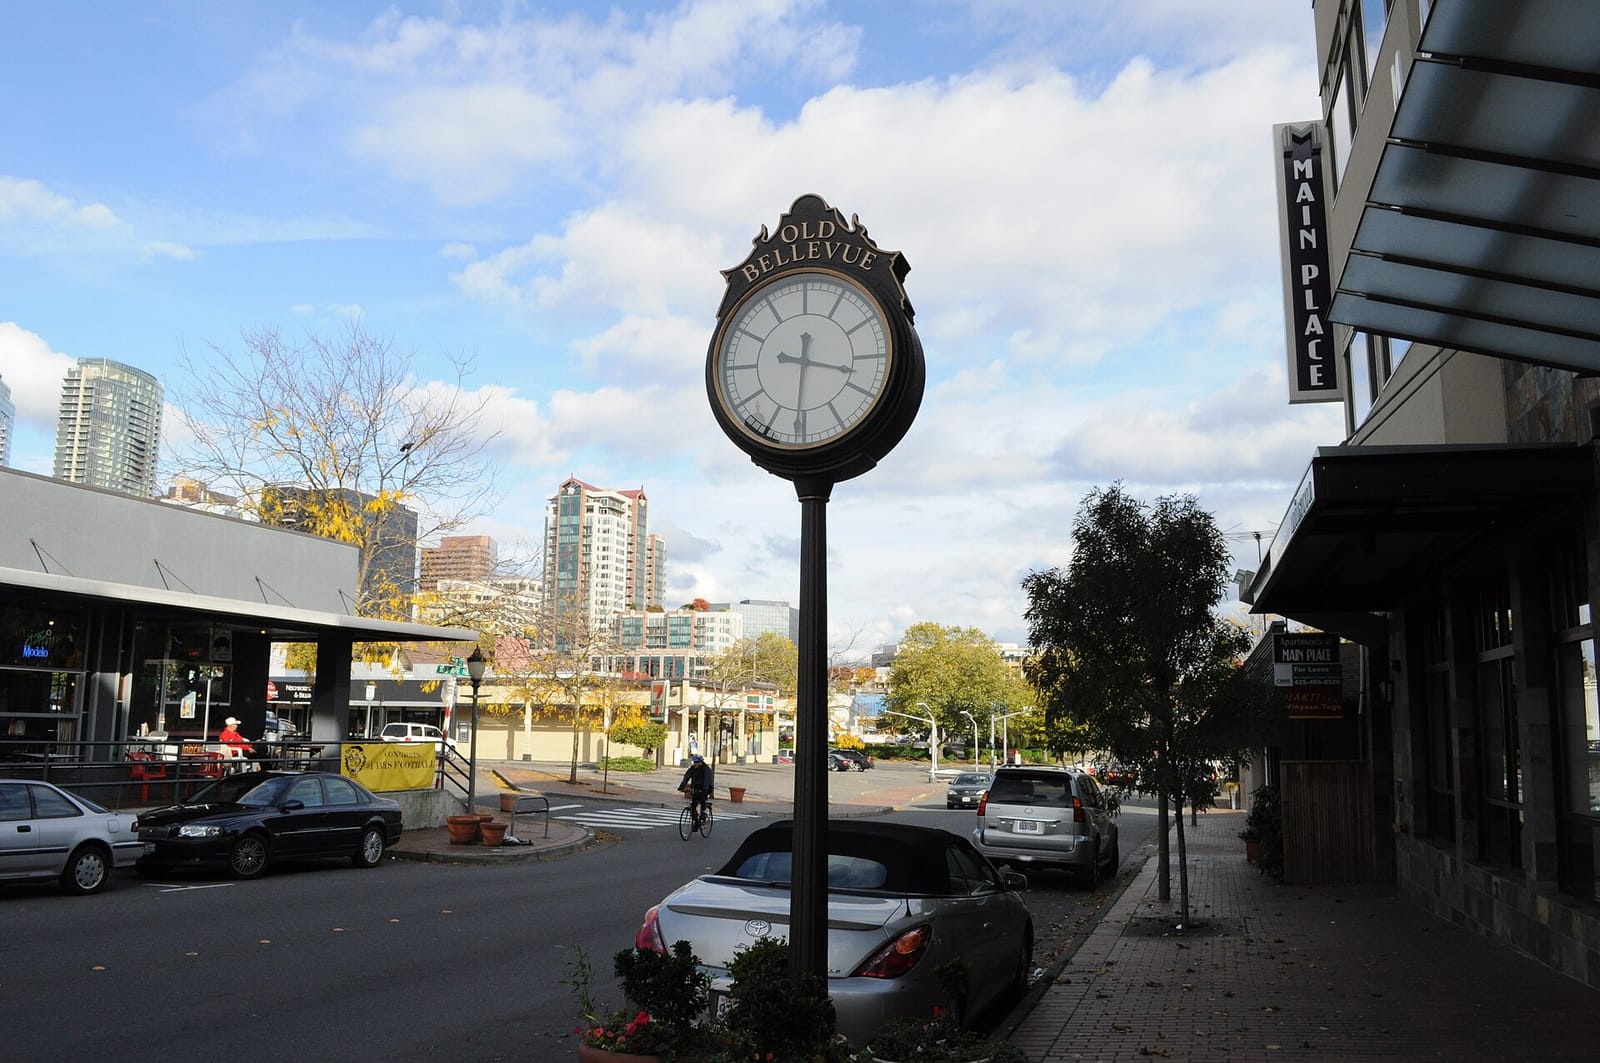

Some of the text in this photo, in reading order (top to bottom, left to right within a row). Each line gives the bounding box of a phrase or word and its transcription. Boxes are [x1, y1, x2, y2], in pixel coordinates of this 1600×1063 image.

[781, 220, 836, 243] OLD
[741, 241, 878, 283] BELLEVUE
[1293, 158, 1324, 386] MAIN PLACE
[23, 645, 49, 658] Modelo
[1282, 648, 1332, 661] MAIN PLACE
